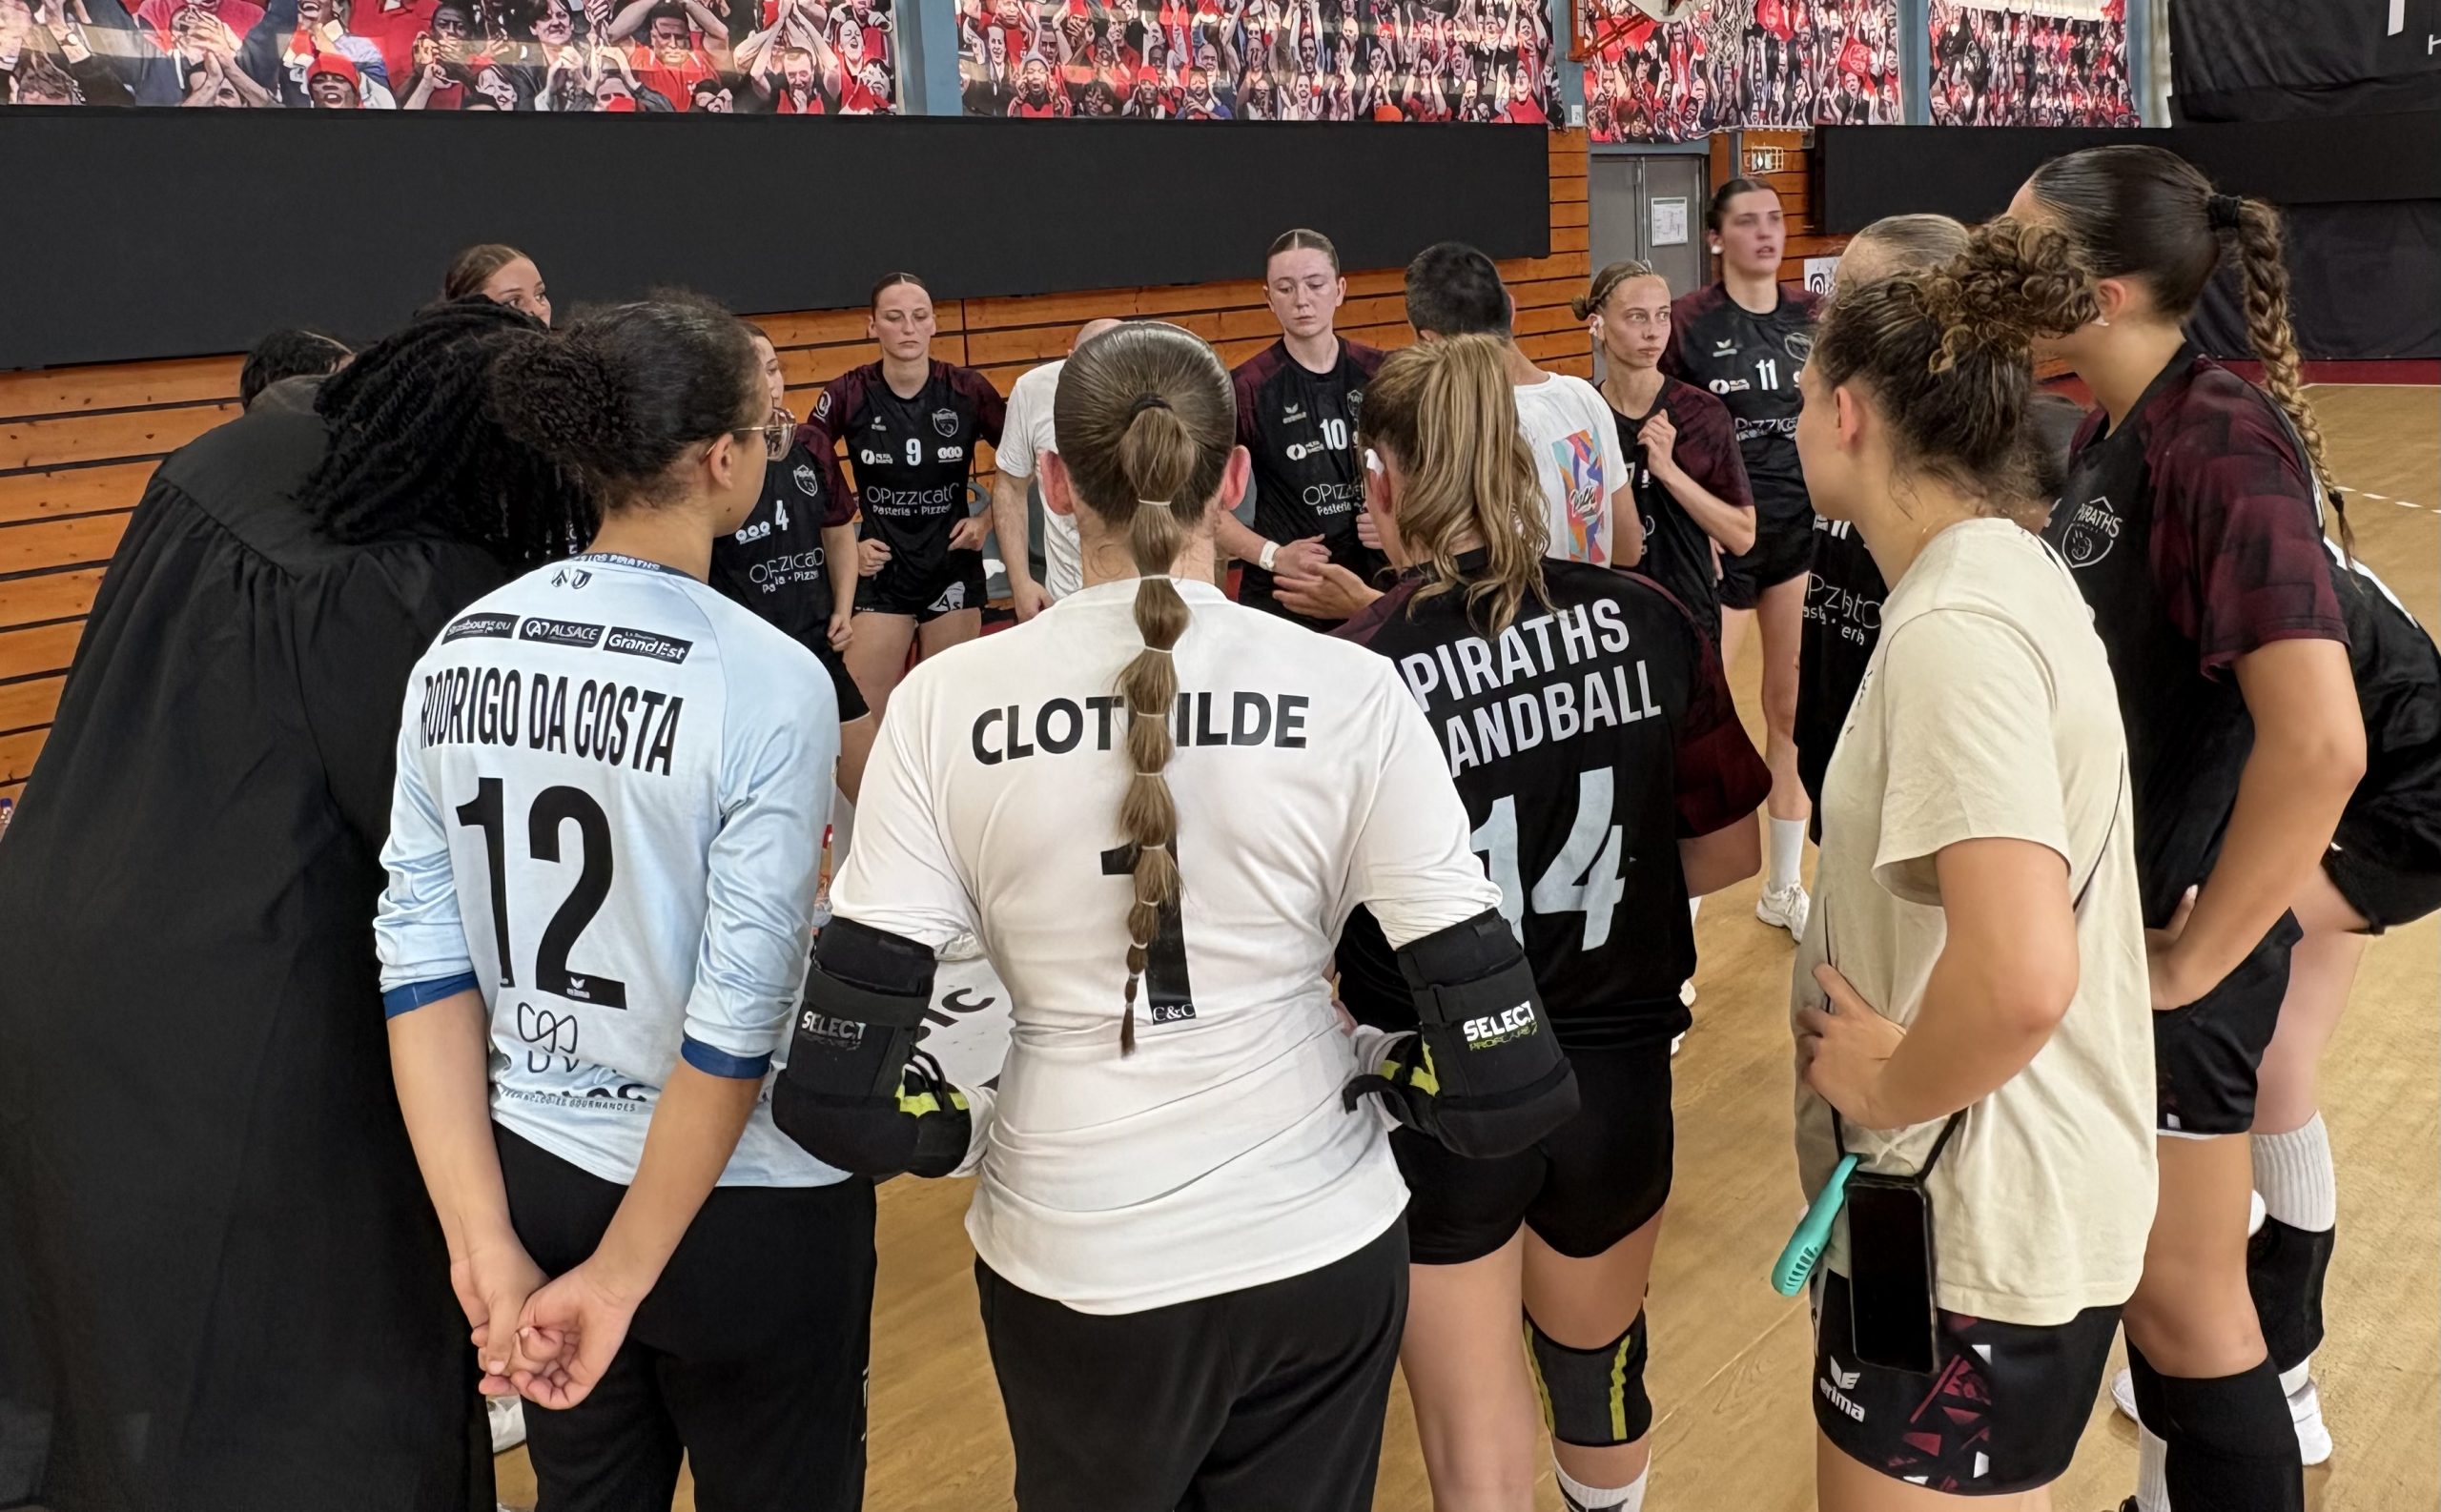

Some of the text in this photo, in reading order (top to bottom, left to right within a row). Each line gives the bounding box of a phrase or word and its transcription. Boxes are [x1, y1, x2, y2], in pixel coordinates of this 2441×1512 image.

[1755, 358, 1778, 390] 11
[1320, 419, 1347, 450] 10
[906, 439, 922, 466] 9
[775, 500, 790, 530] 4
[549, 624, 599, 640] ALSACE
[1401, 598, 1630, 713] PIRATHS
[421, 666, 684, 777] RODRIGO DA COSTA
[972, 691, 1309, 765] CLOTILDE
[1446, 660, 1662, 779] ANDBALL
[1469, 766, 1626, 951] 14
[456, 778, 627, 1011] 12
[802, 1011, 867, 1040] SELECT
[1153, 1003, 1195, 1022] C&C
[1463, 1000, 1535, 1042] SELECT
[569, 1097, 636, 1113] GOURMANDES
